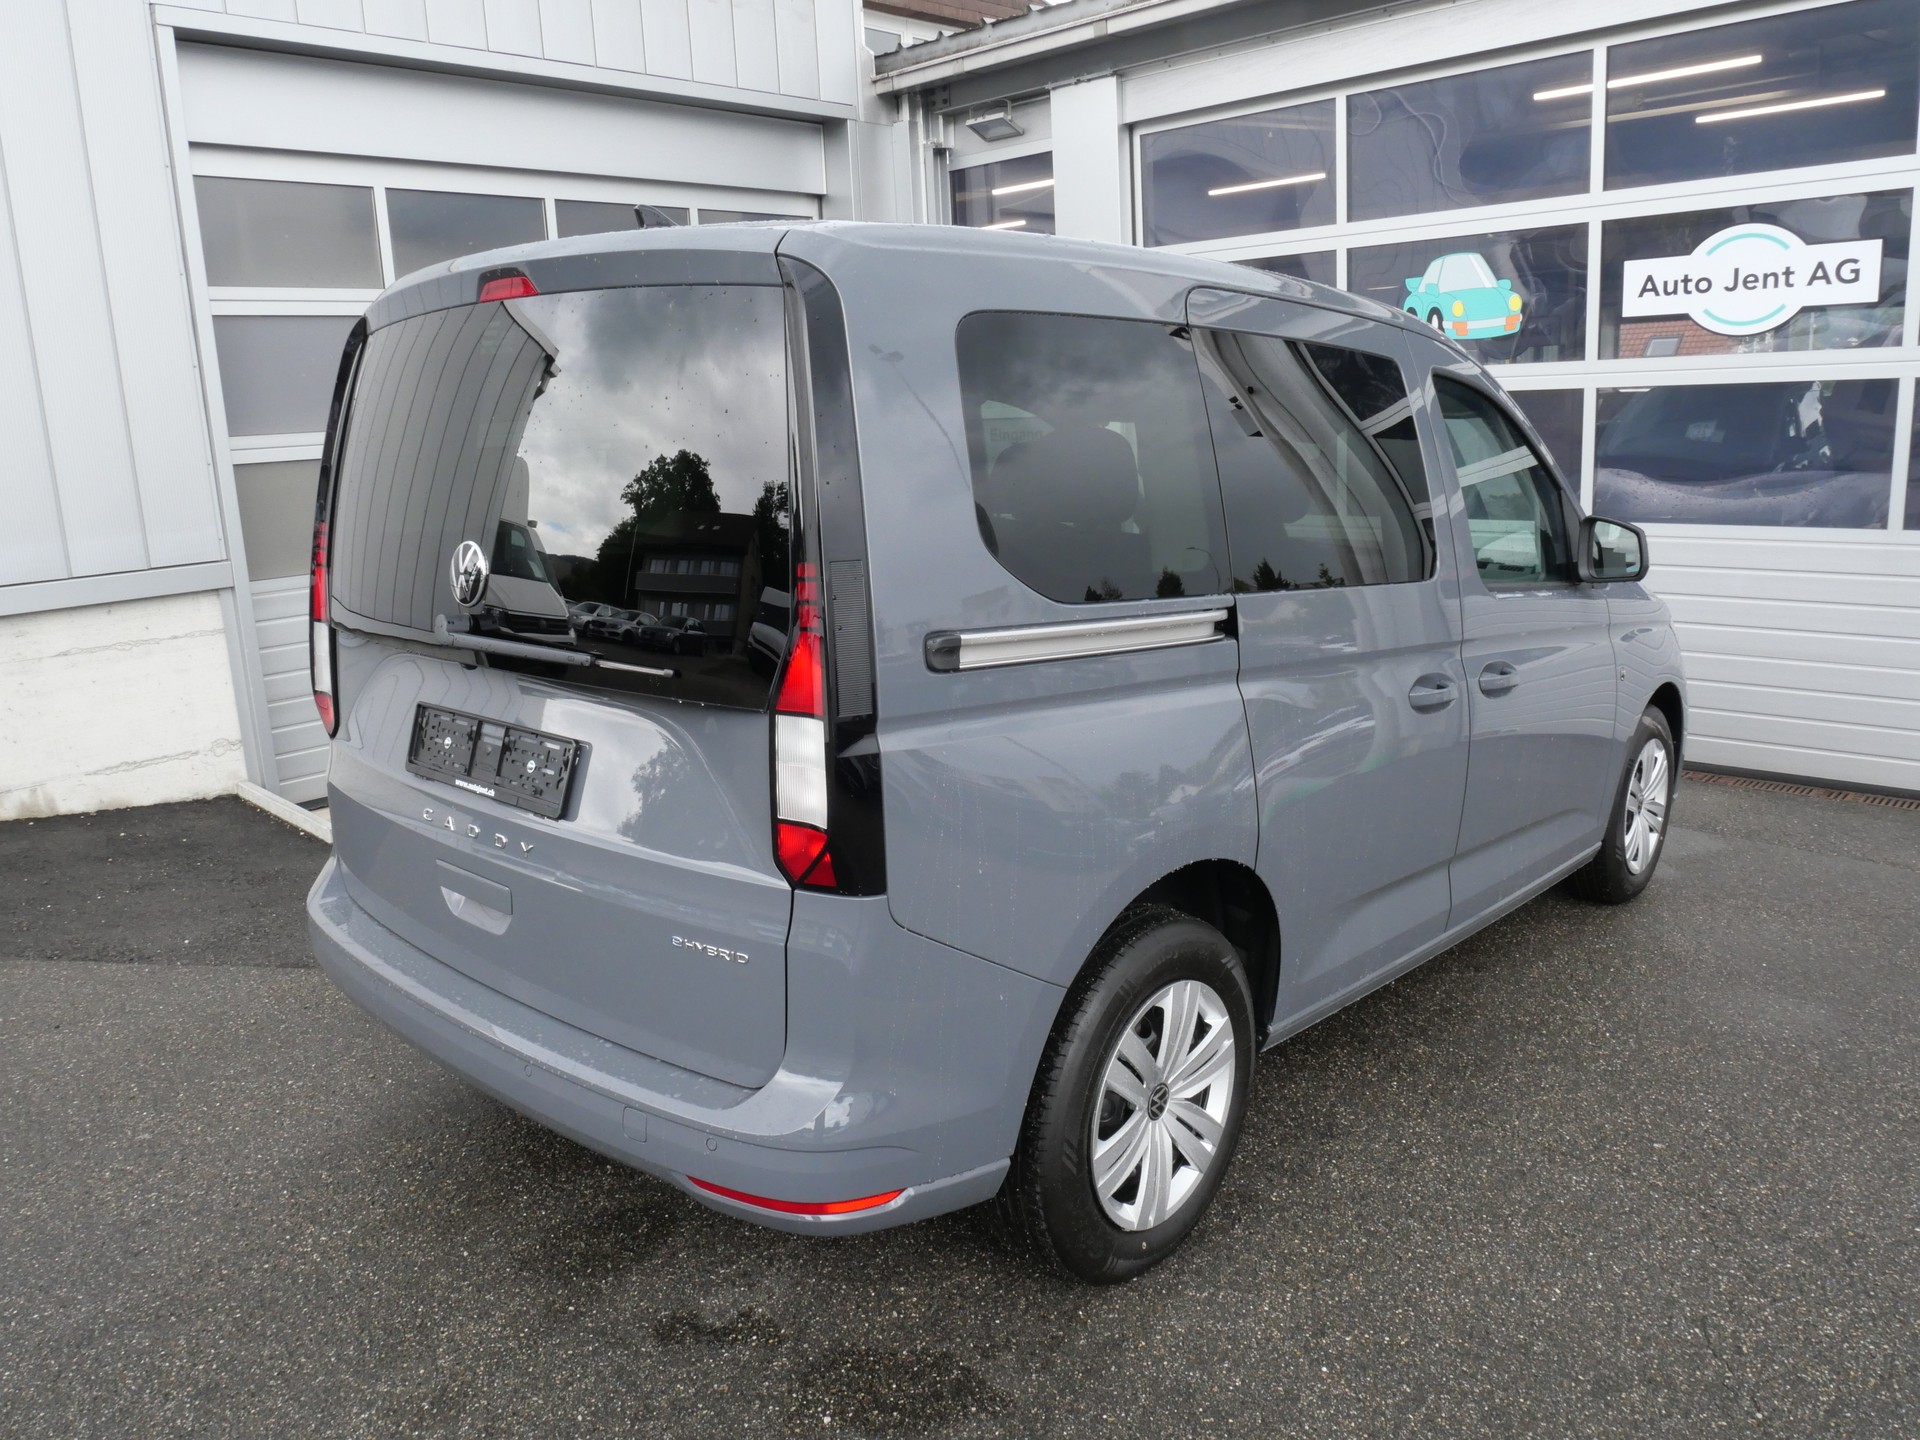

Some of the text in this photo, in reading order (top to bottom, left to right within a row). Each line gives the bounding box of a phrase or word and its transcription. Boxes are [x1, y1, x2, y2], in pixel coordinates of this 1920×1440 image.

[1637, 258, 1861, 298] Auto Jent AG
[422, 807, 534, 858] CADDY
